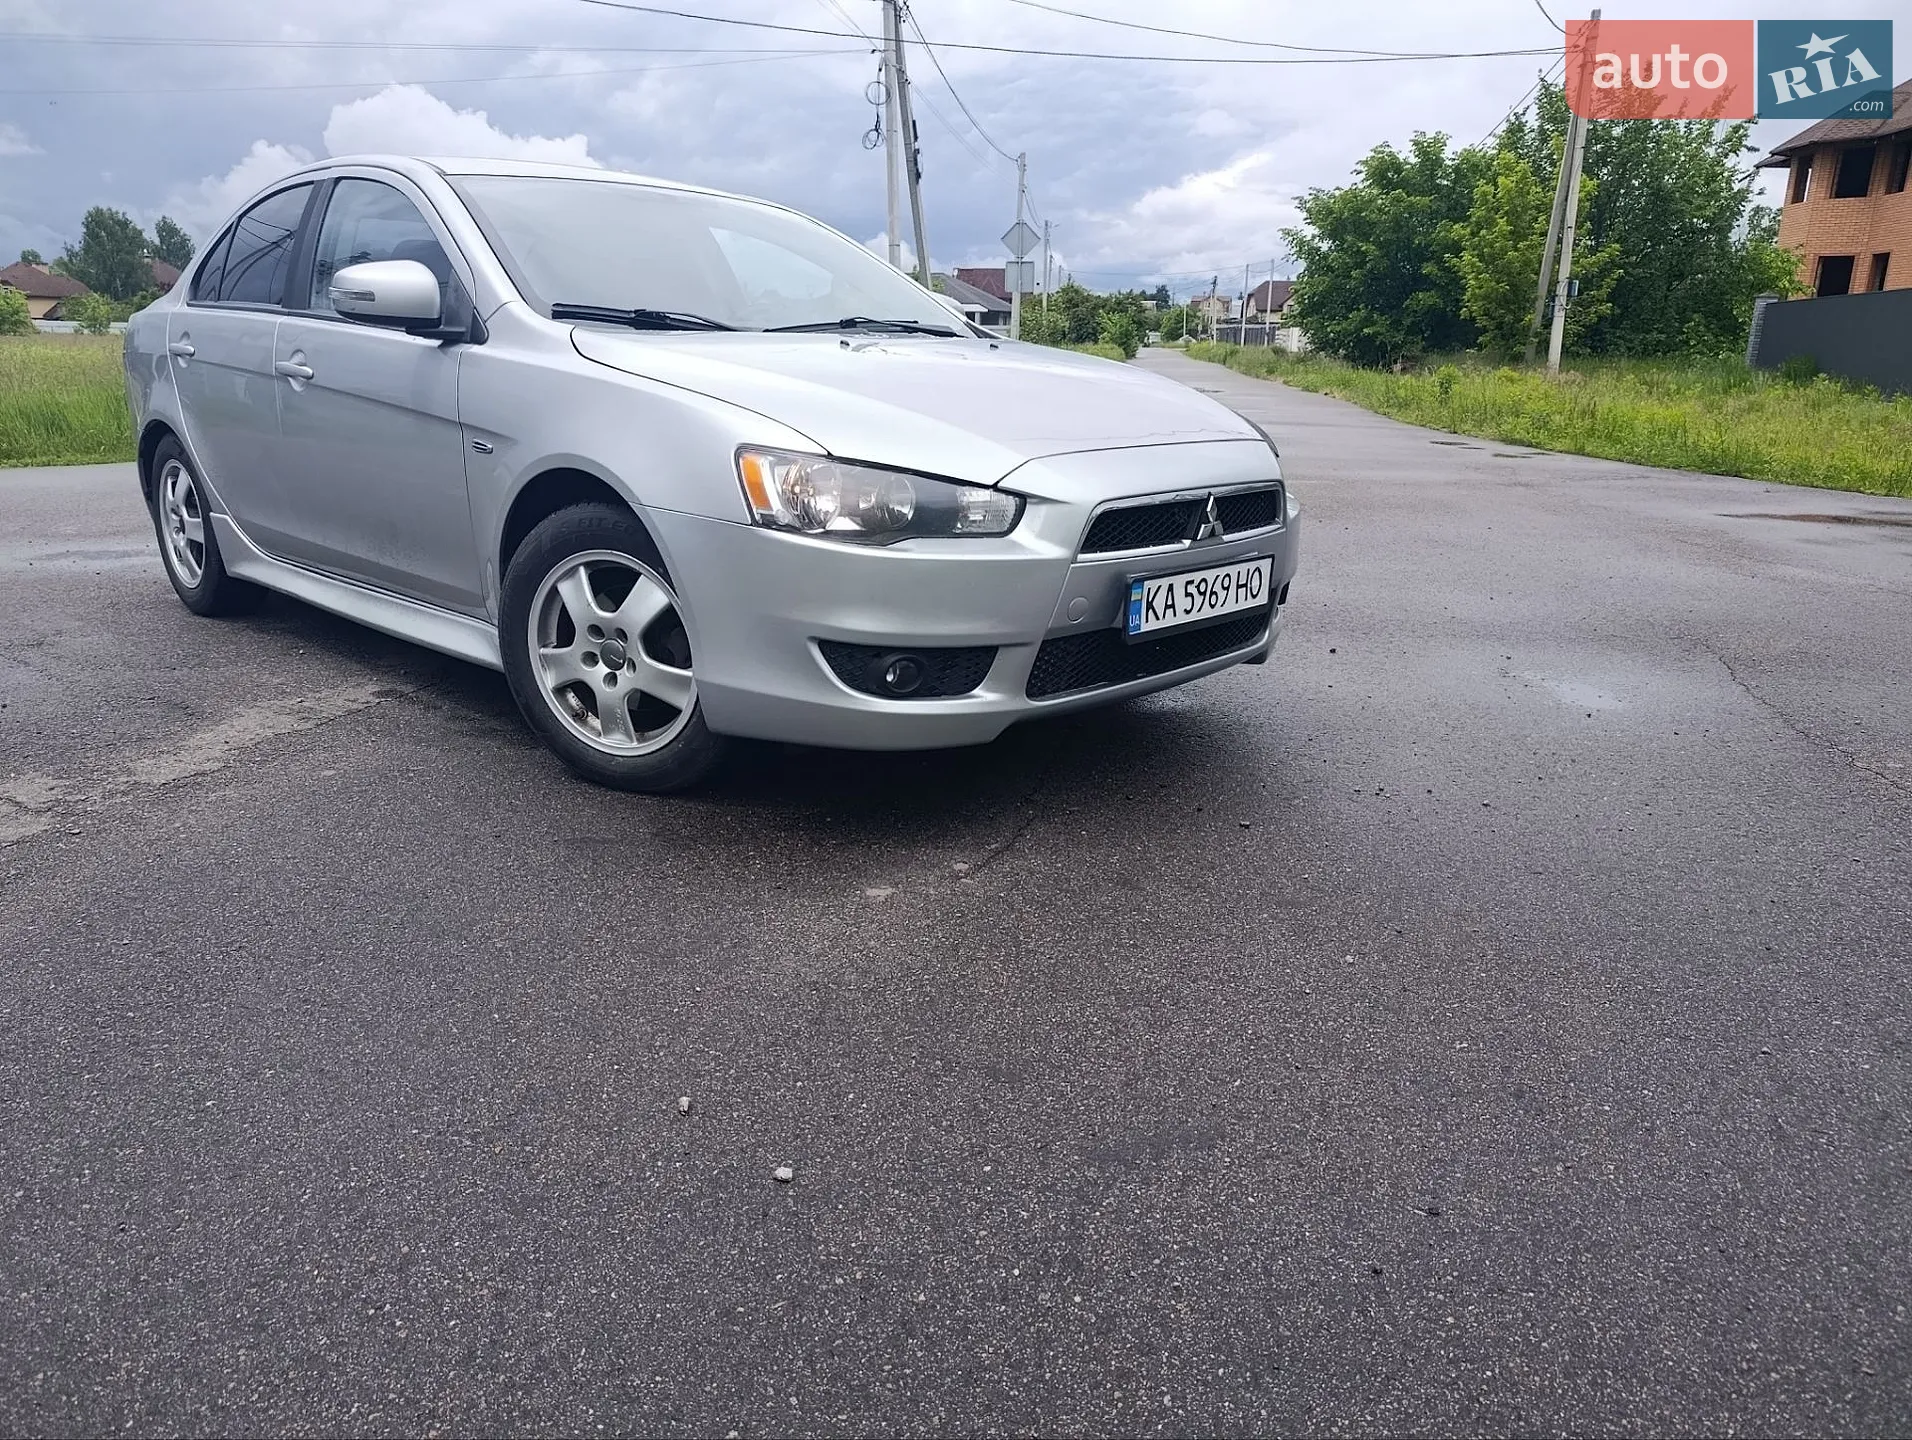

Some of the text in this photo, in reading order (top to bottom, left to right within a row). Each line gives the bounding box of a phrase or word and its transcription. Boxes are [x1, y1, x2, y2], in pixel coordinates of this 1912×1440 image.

[1145, 566, 1263, 623] KA 5969 HO
[1129, 614, 1140, 627] UA
